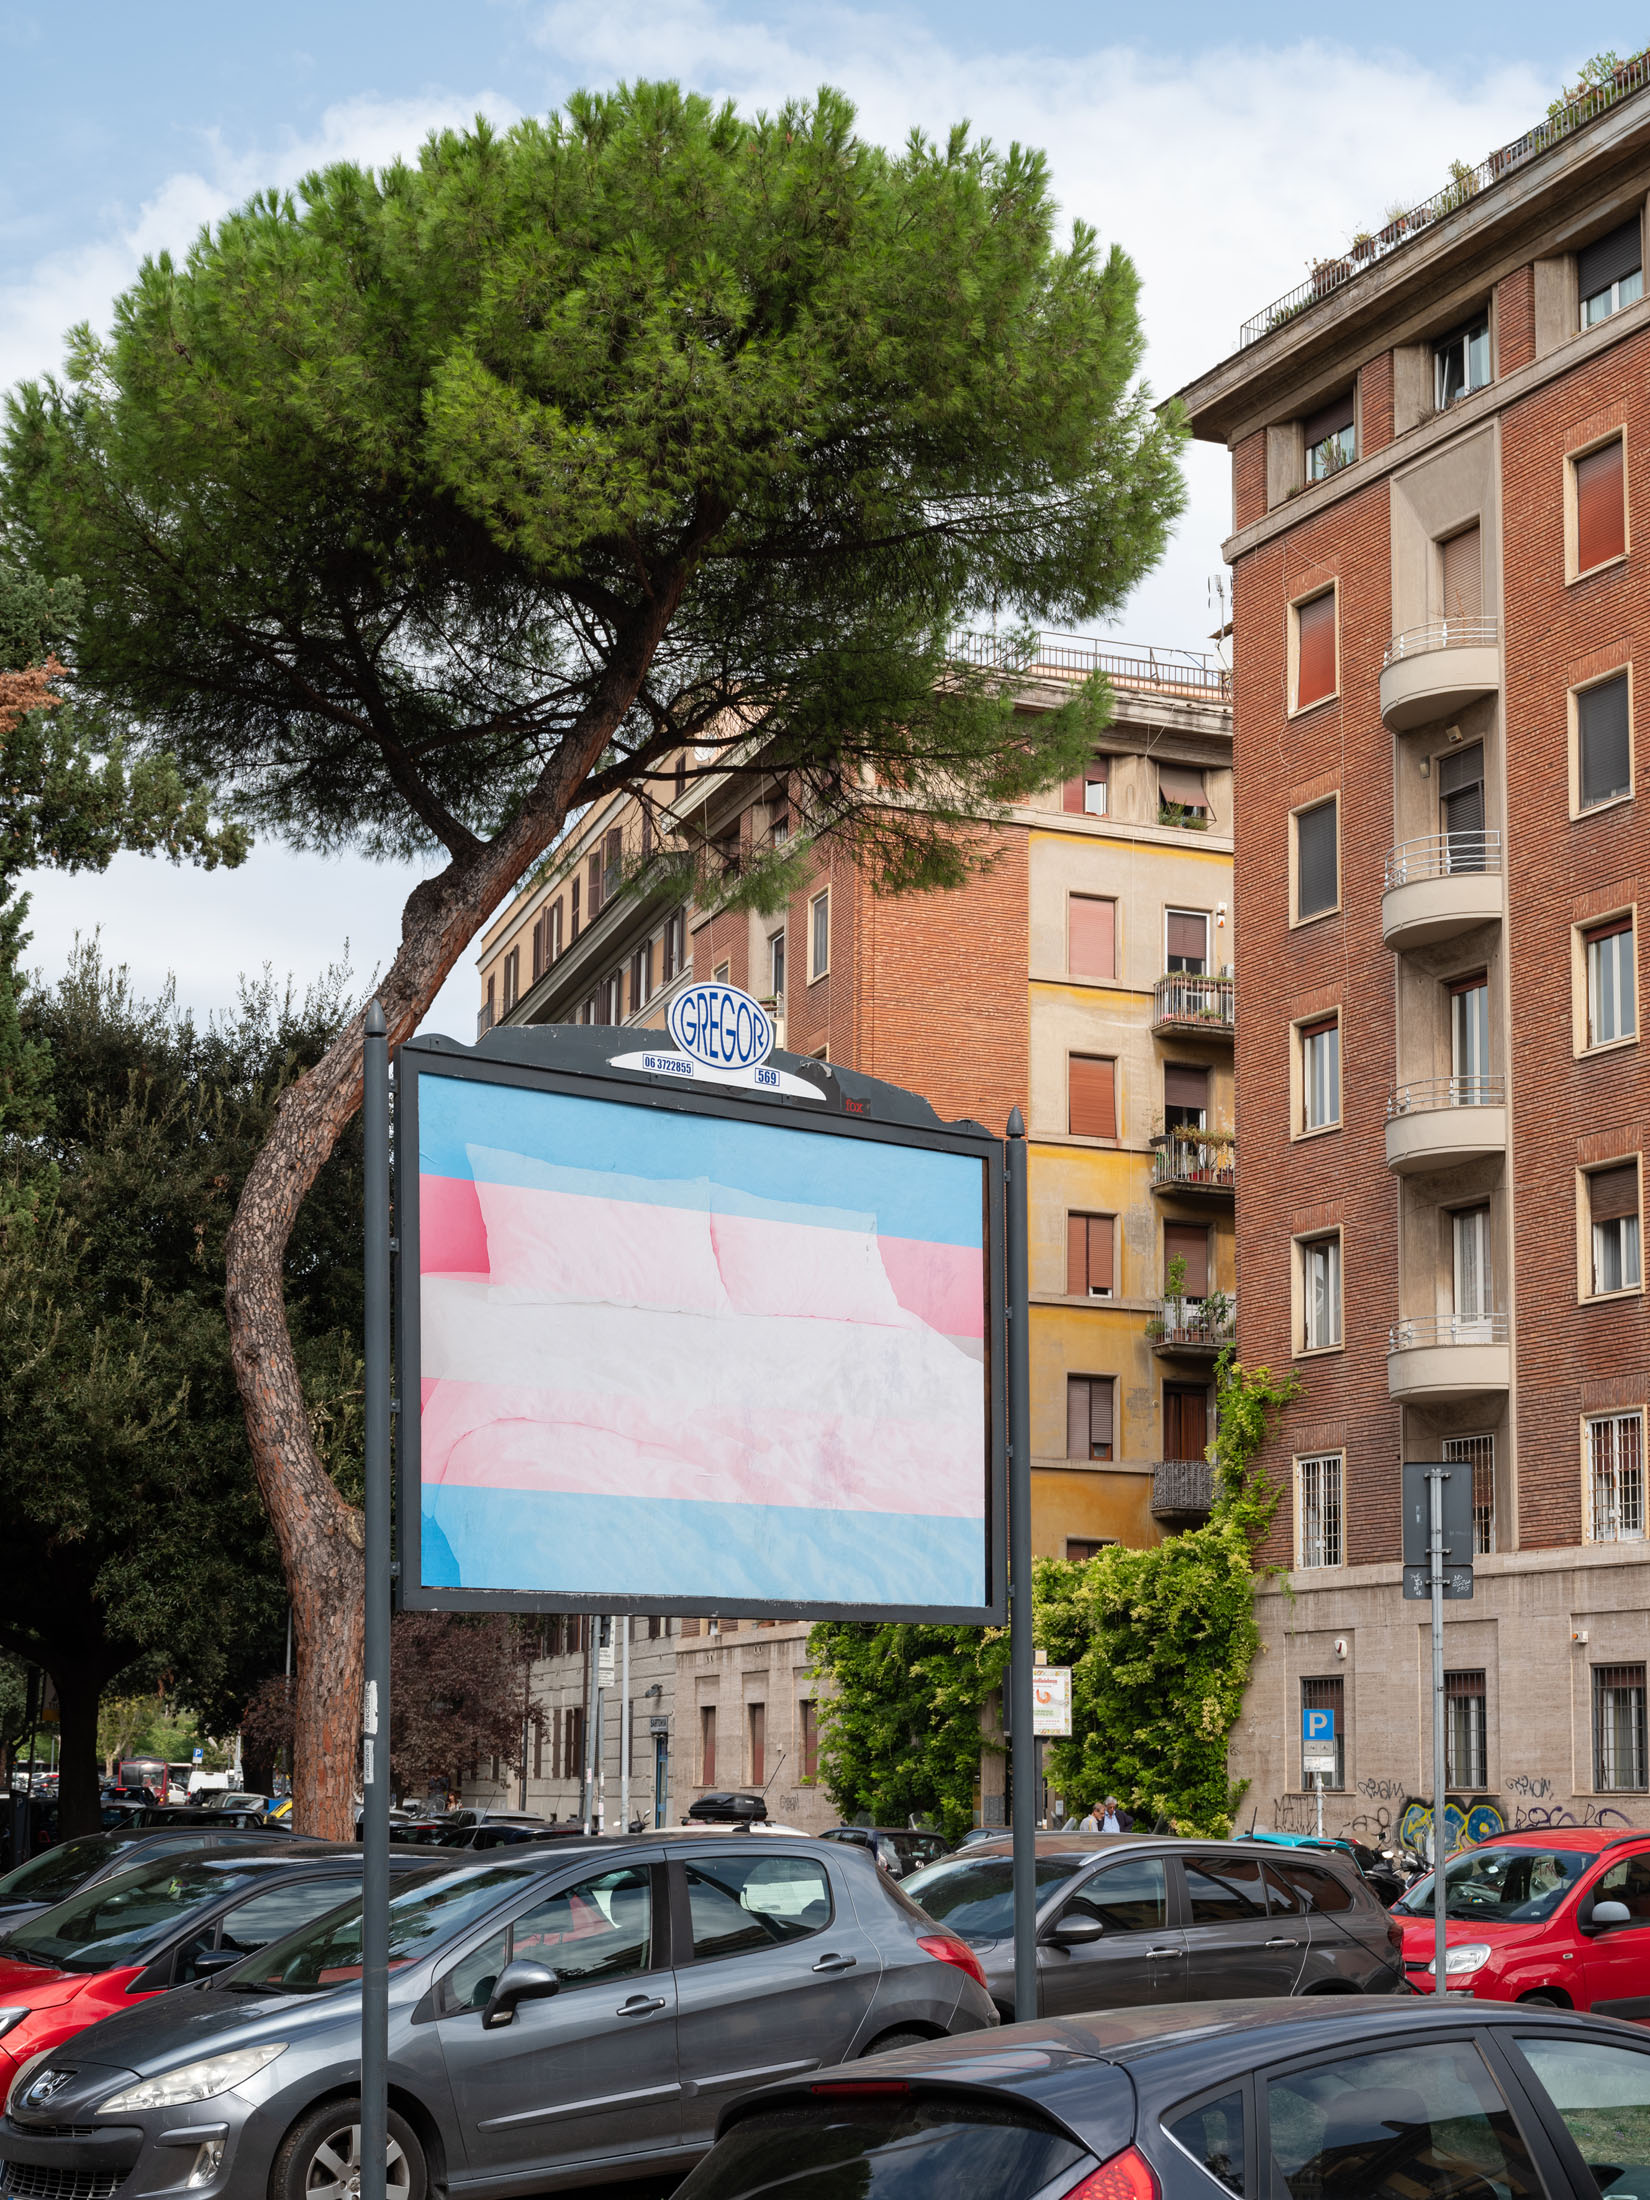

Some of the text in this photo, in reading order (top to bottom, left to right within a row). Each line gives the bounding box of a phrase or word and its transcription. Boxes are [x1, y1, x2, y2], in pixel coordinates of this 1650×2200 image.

[680, 991, 765, 1063] GREGOR
[644, 1056, 692, 1075] 06 3722855
[757, 1070, 777, 1085] 569
[845, 1098, 864, 1113] fox
[1309, 1712, 1328, 1737] P
